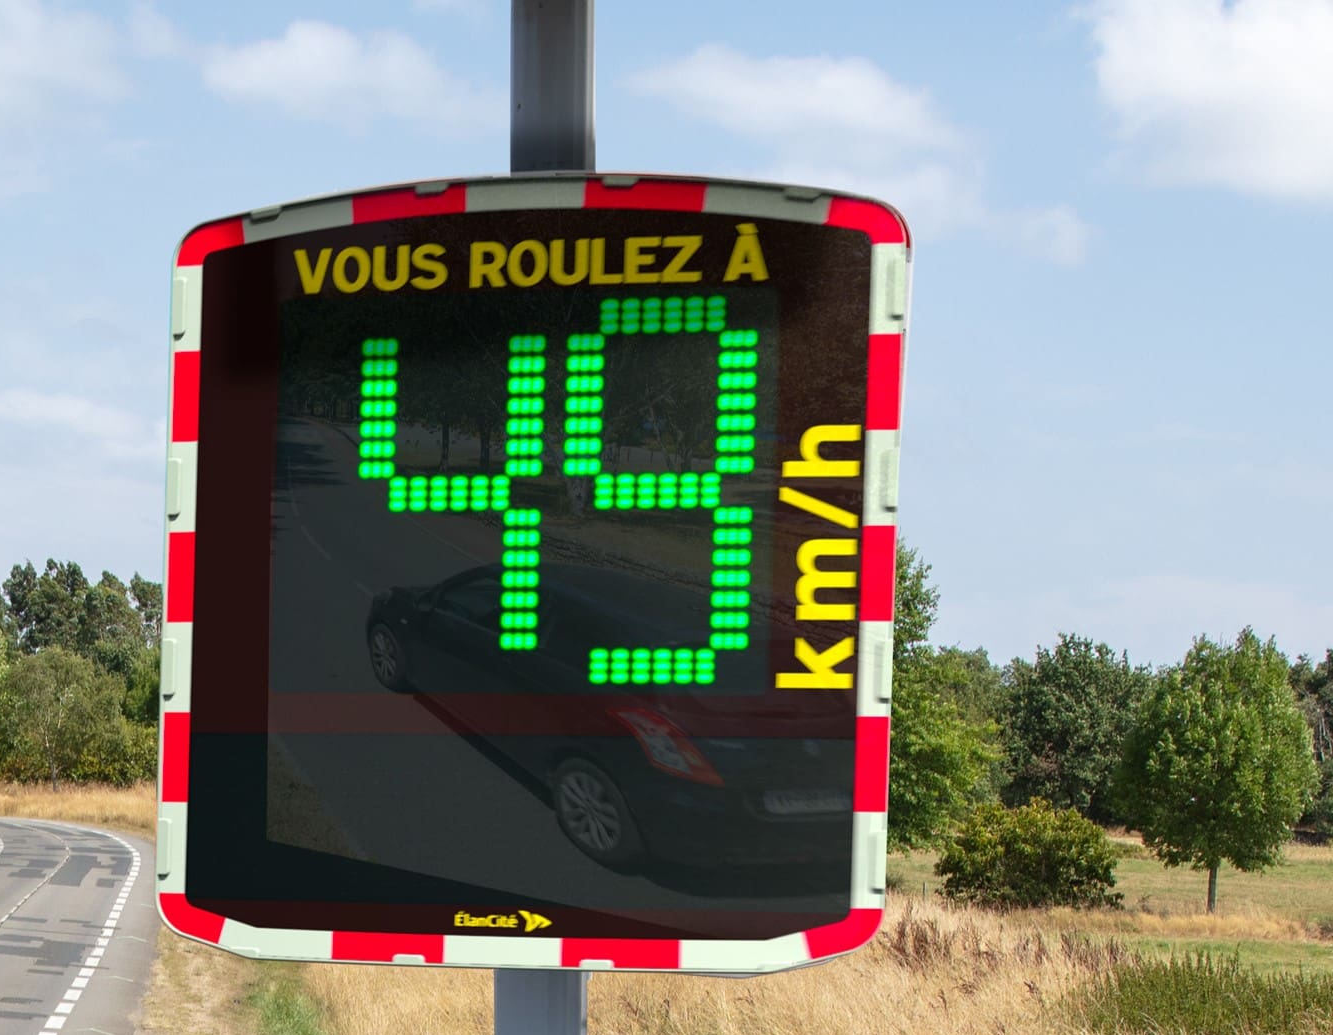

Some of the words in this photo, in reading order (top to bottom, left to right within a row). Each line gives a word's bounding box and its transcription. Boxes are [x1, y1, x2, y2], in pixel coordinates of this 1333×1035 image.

[293, 243, 449, 295] VOUS
[468, 234, 703, 289] ROULEZ
[722, 222, 770, 283] À
[358, 296, 759, 685] 49
[775, 423, 862, 690] km/h
